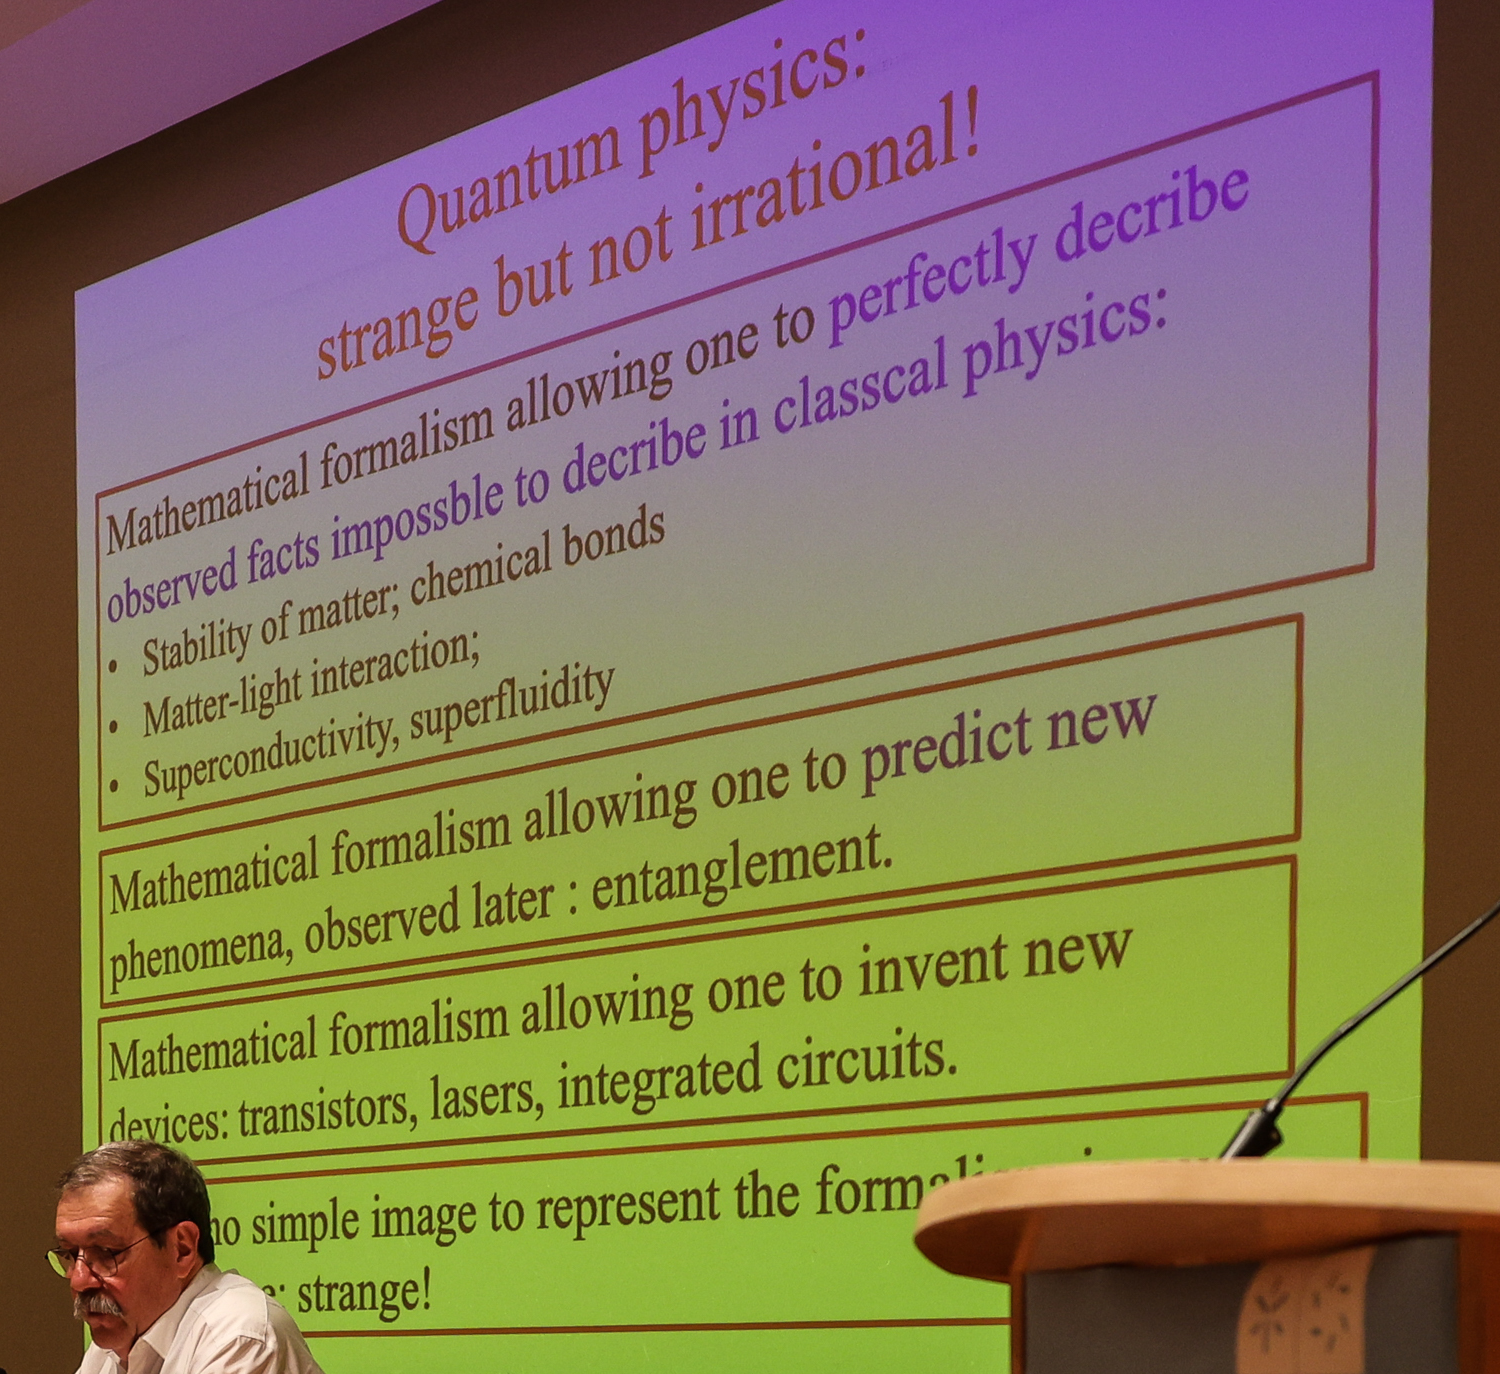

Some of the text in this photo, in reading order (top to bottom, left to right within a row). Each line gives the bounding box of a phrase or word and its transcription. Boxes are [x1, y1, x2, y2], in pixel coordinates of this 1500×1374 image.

[397, 27, 865, 255] Quantum physics:
[318, 84, 979, 381] strange but not irrational!
[106, 164, 1250, 556] Mathematical formalism allowing one to perfectly decribe
[107, 288, 1167, 624] observed facts impossble to decribe in classcal physics:
[143, 502, 666, 677] Stability of matter; chemical bonds
[143, 629, 480, 738] Matter-light interaction;
[144, 661, 616, 802] Superconductivity, superfluidity
[109, 694, 1158, 915] Mathematical formalism allowing one to predict new
[109, 928, 294, 996] phenomena,
[304, 884, 461, 954] observed
[471, 880, 556, 929] later
[592, 823, 893, 911] entanglement.
[108, 928, 1134, 1082] Mathematical formalism allowing one to invent new
[110, 1026, 957, 1143] devices: transistors, lasers, integrated circuits.
[252, 1195, 360, 1254] simple
[371, 1193, 477, 1248] image
[488, 1192, 525, 1233] to
[536, 1178, 721, 1242] represent
[733, 1168, 800, 1220] the
[298, 1266, 430, 1323] strange!
